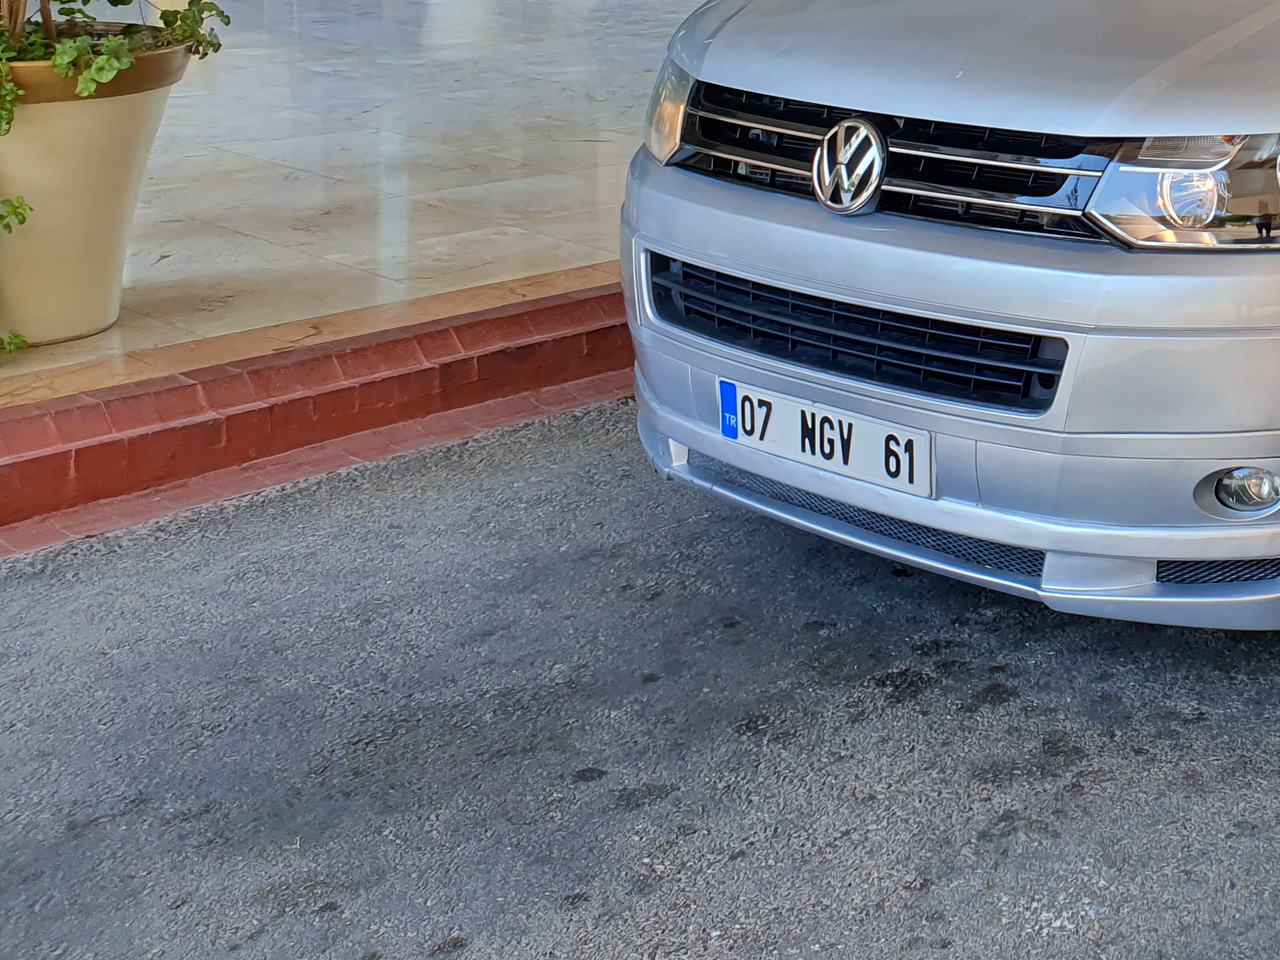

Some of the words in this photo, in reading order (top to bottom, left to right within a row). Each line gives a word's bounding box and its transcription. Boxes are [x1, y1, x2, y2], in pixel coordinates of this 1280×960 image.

[724, 412, 737, 428] TR
[740, 395, 772, 441] 07
[800, 409, 853, 465] NGV
[884, 433, 915, 484] 61
